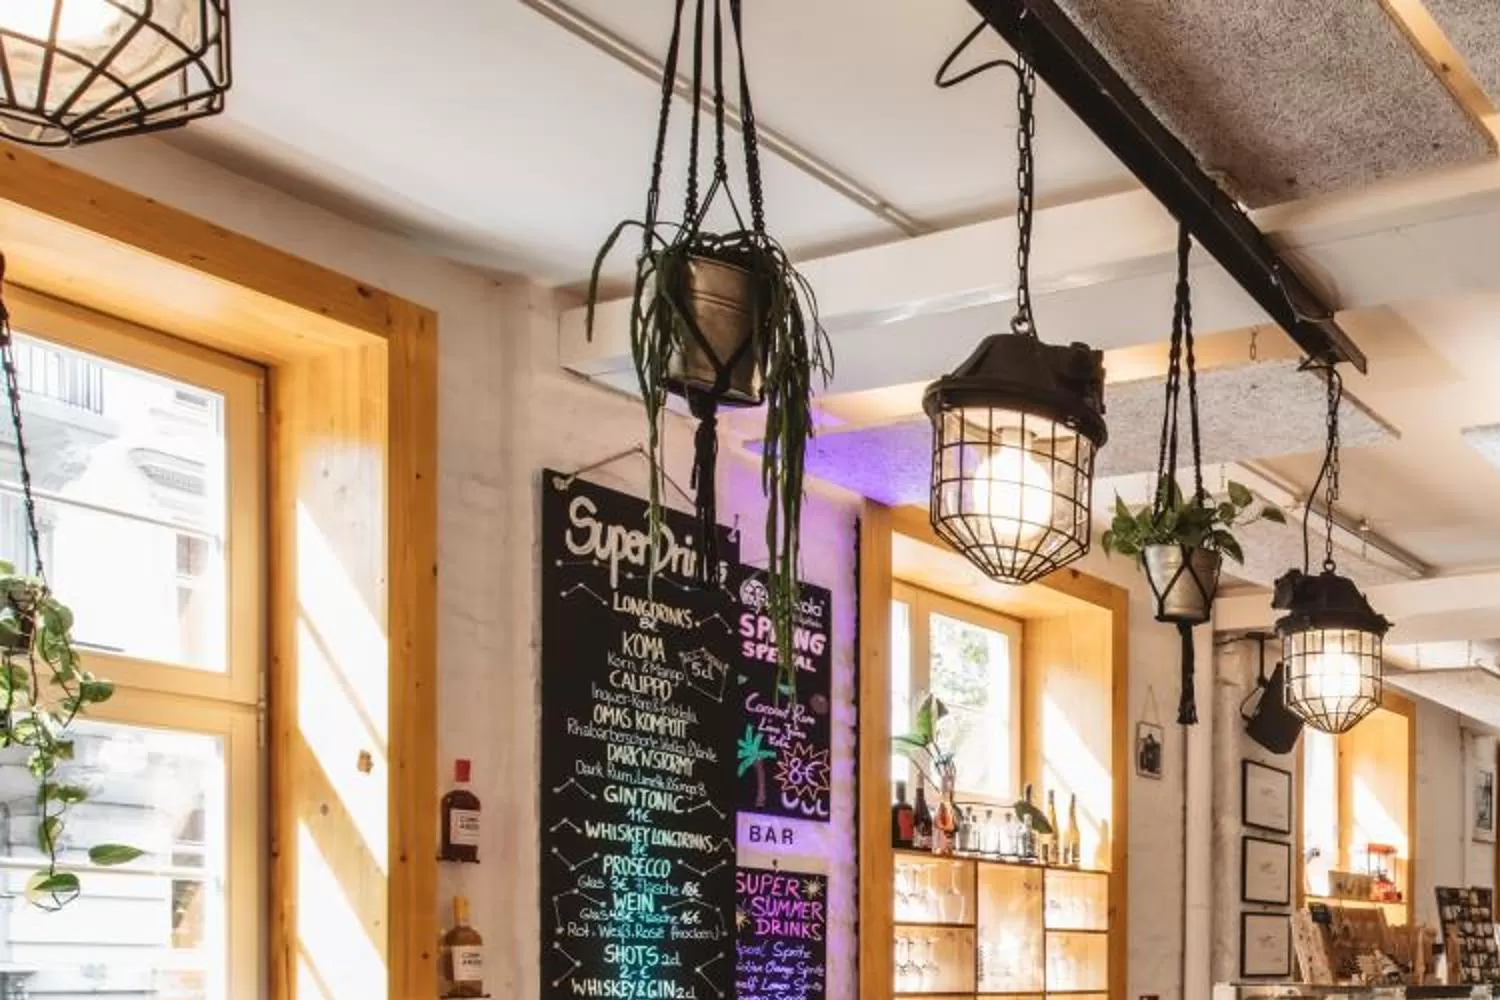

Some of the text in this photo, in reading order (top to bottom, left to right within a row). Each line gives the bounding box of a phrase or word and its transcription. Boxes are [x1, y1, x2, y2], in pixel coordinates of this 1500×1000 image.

[613, 592, 693, 629] LONGDRINKS
[621, 631, 666, 663] KOMA
[609, 669, 672, 702] CALIPPO
[593, 703, 632, 729] OMAS
[585, 820, 650, 846] WHISKEY
[749, 825, 793, 846] BAR
[603, 855, 671, 879] PROSECCO
[736, 872, 800, 899] SUPER
[612, 893, 655, 913] WEIN
[751, 895, 824, 923] SUMMER
[755, 917, 822, 941] DRINKS
[603, 944, 659, 966] SHOTS
